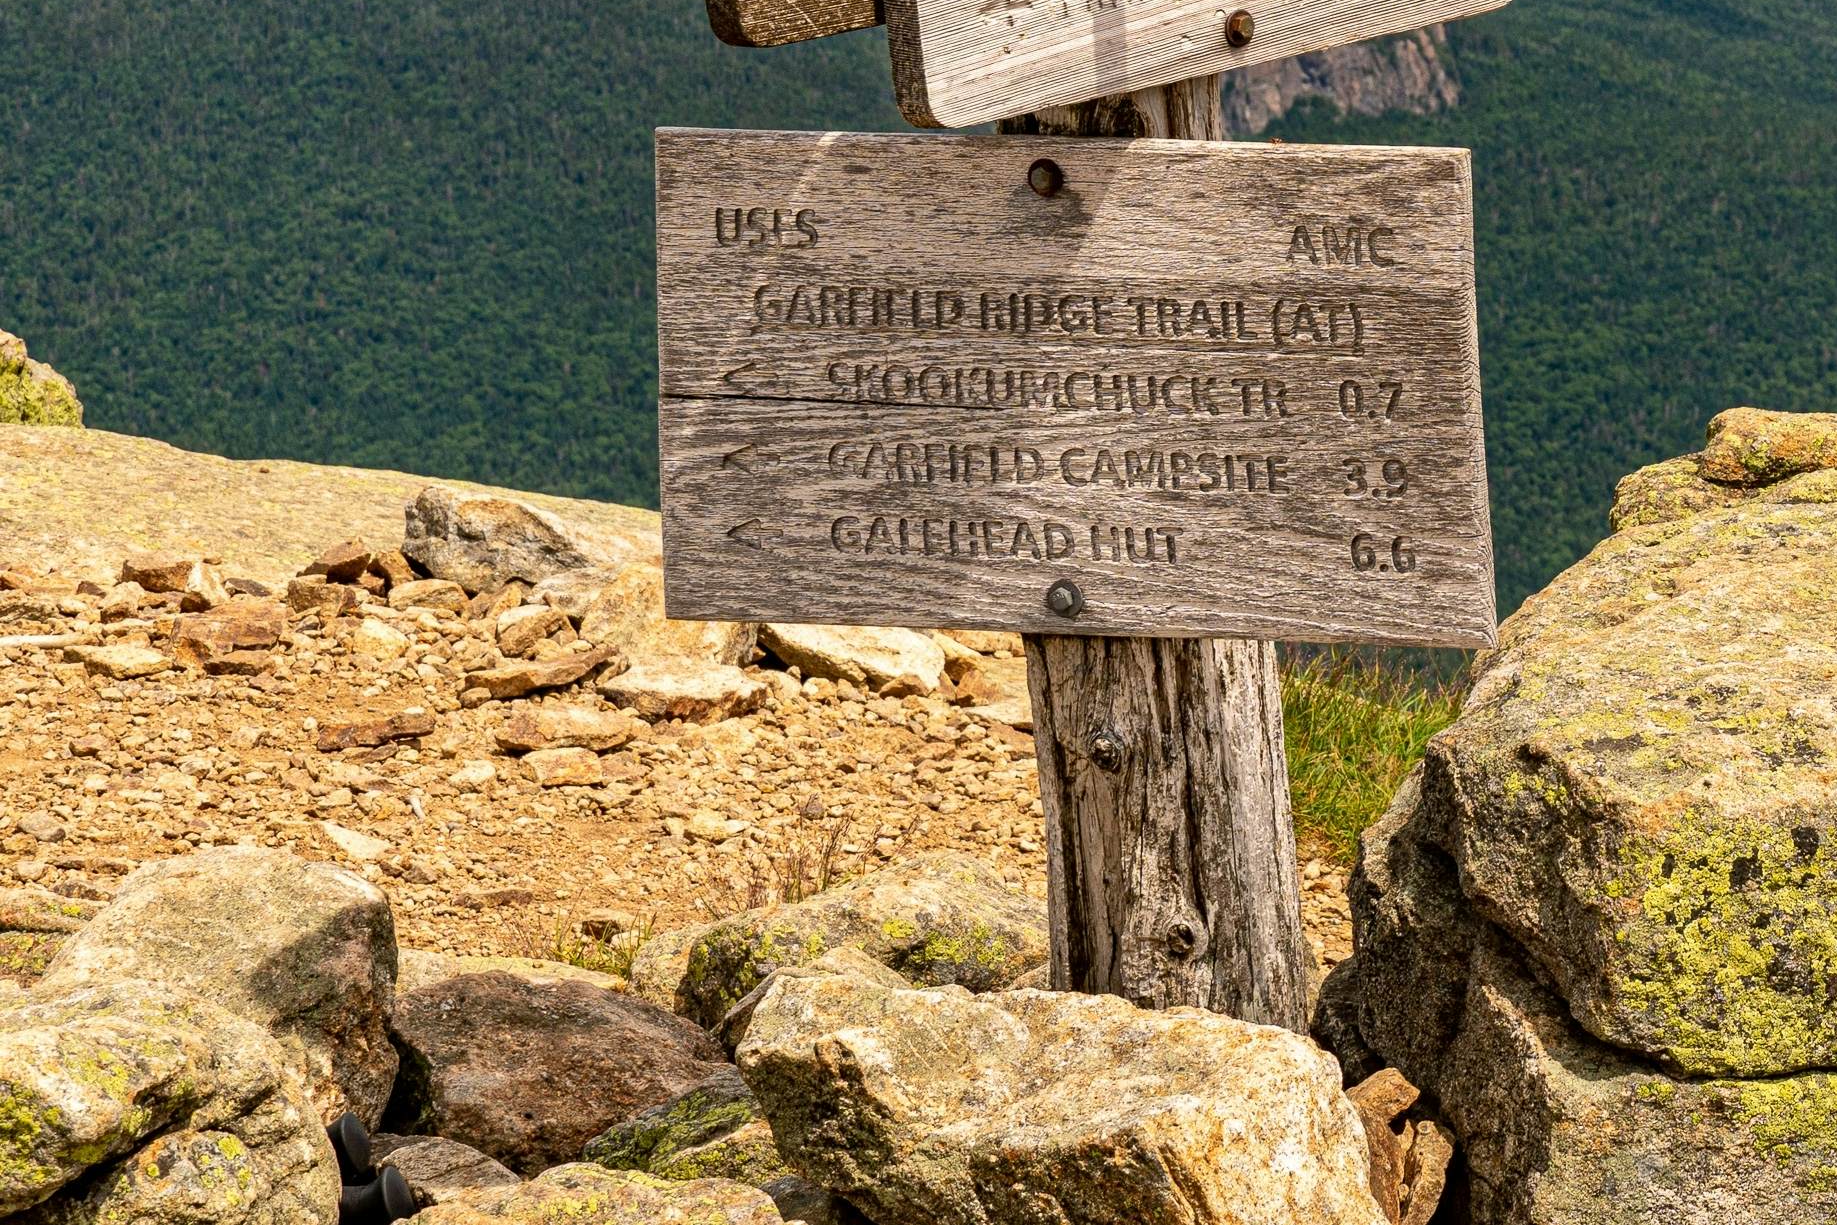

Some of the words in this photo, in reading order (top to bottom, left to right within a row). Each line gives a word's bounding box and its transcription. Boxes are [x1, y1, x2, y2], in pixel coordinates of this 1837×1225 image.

[715, 207, 819, 249] USFS
[1286, 225, 1396, 268] AMC
[755, 283, 965, 329] GARFIELD
[980, 291, 1114, 336] RIDGE
[1127, 296, 1258, 341] TRAIL
[1271, 300, 1365, 356] (AT)
[827, 361, 1219, 416] SKOOKUMCHUCK
[1231, 378, 1289, 419] TR
[1338, 380, 1403, 420] 0.7
[828, 441, 1045, 486] GARFIELD
[1060, 448, 1290, 494] CAMPSITE
[1343, 459, 1408, 498] 3.9
[830, 515, 1075, 561] GALEHEAD
[1090, 527, 1184, 565] HUT
[1350, 533, 1416, 573] 6.6
